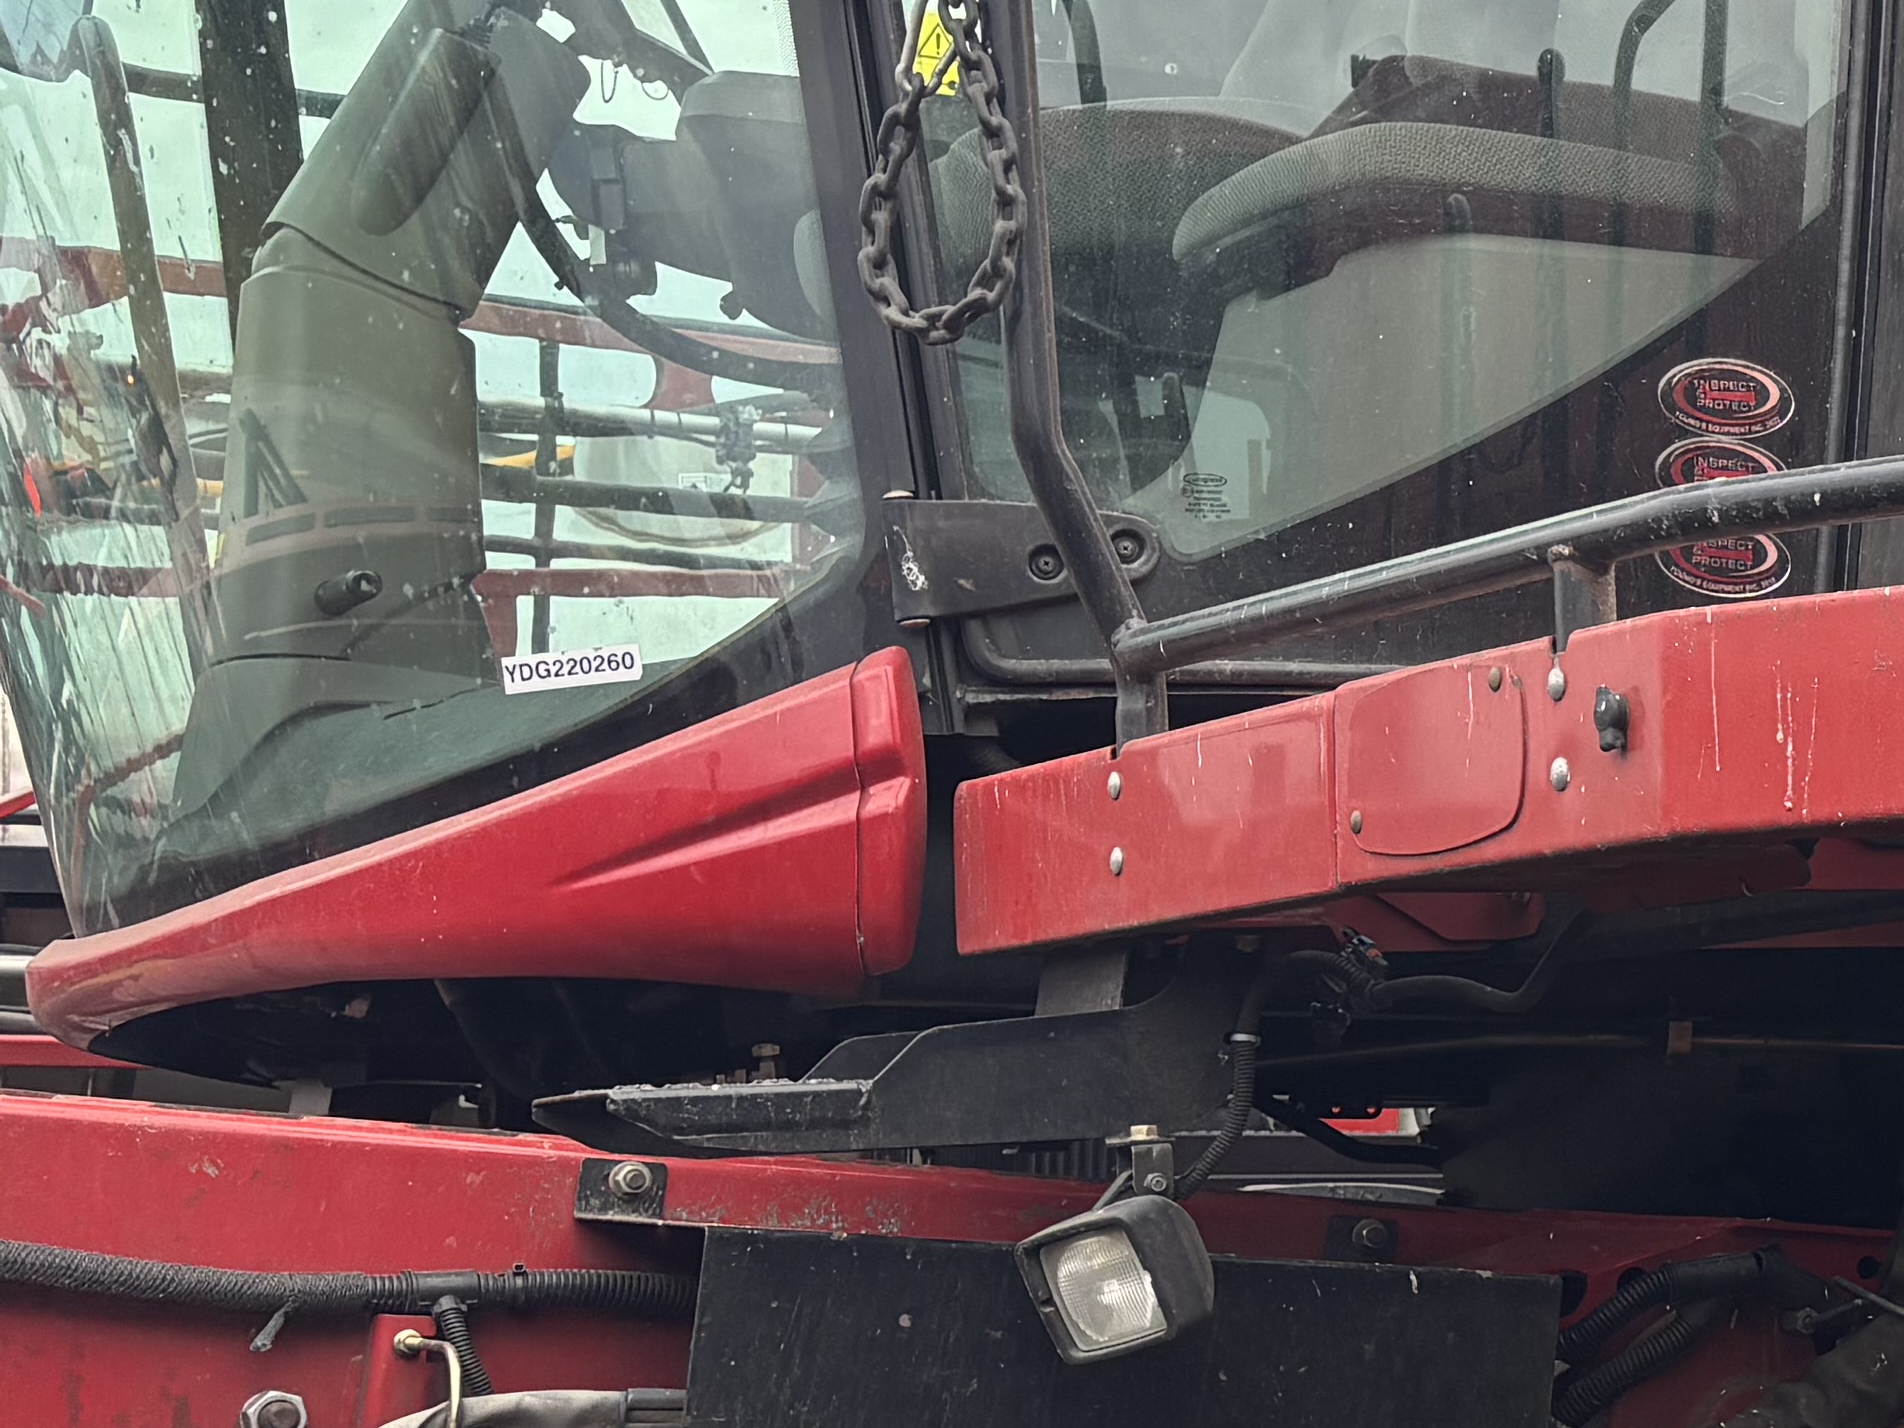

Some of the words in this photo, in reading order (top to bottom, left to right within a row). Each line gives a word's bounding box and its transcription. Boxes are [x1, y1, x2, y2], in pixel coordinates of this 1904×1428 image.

[1696, 398, 1756, 411] PROTECT
[1693, 455, 1757, 472] INSPECT
[1694, 538, 1754, 551] NSPECT
[1691, 556, 1754, 570] PROTECT
[504, 651, 636, 684] YDG220260
